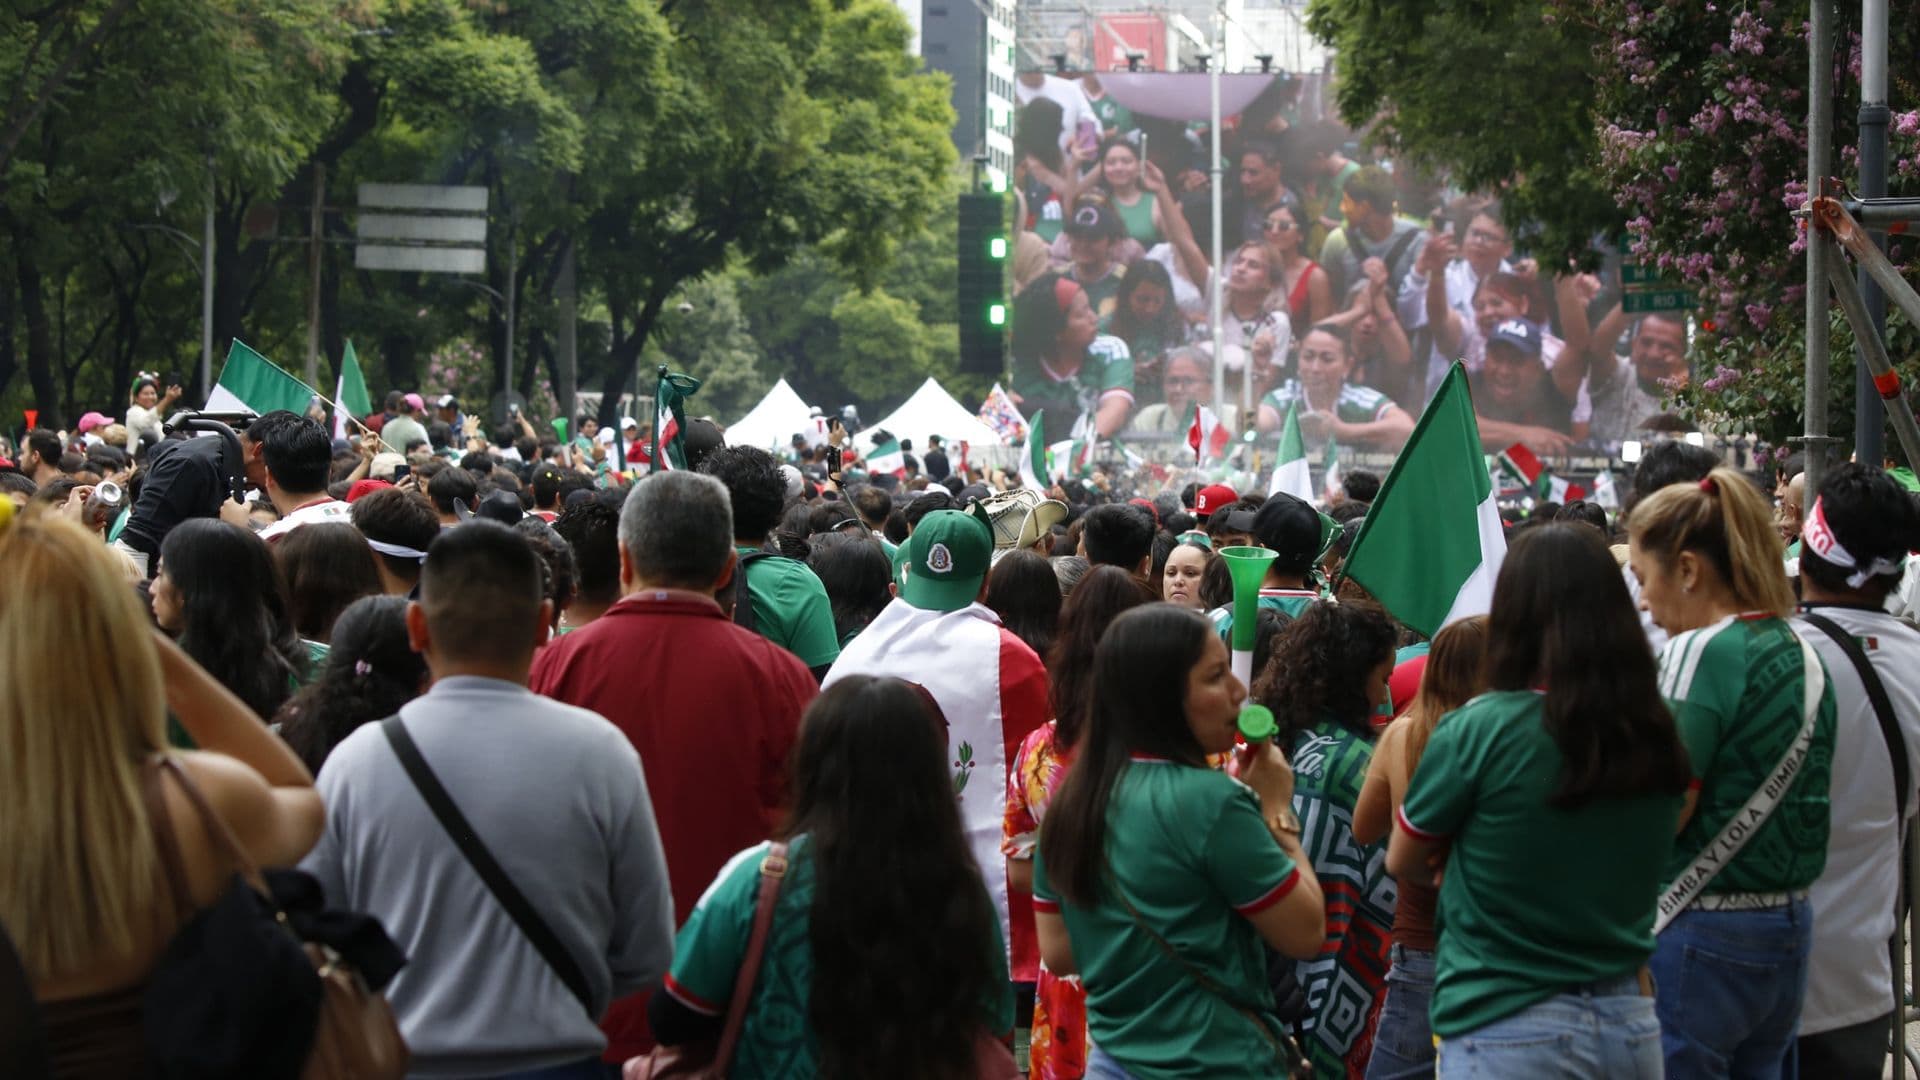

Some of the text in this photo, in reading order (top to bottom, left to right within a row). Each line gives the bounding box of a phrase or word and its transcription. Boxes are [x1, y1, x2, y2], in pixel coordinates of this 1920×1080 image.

[1198, 495, 1206, 509] B
[1765, 748, 1806, 800] BIMBA
[1660, 808, 1763, 915] BIMBA Y LOLA
